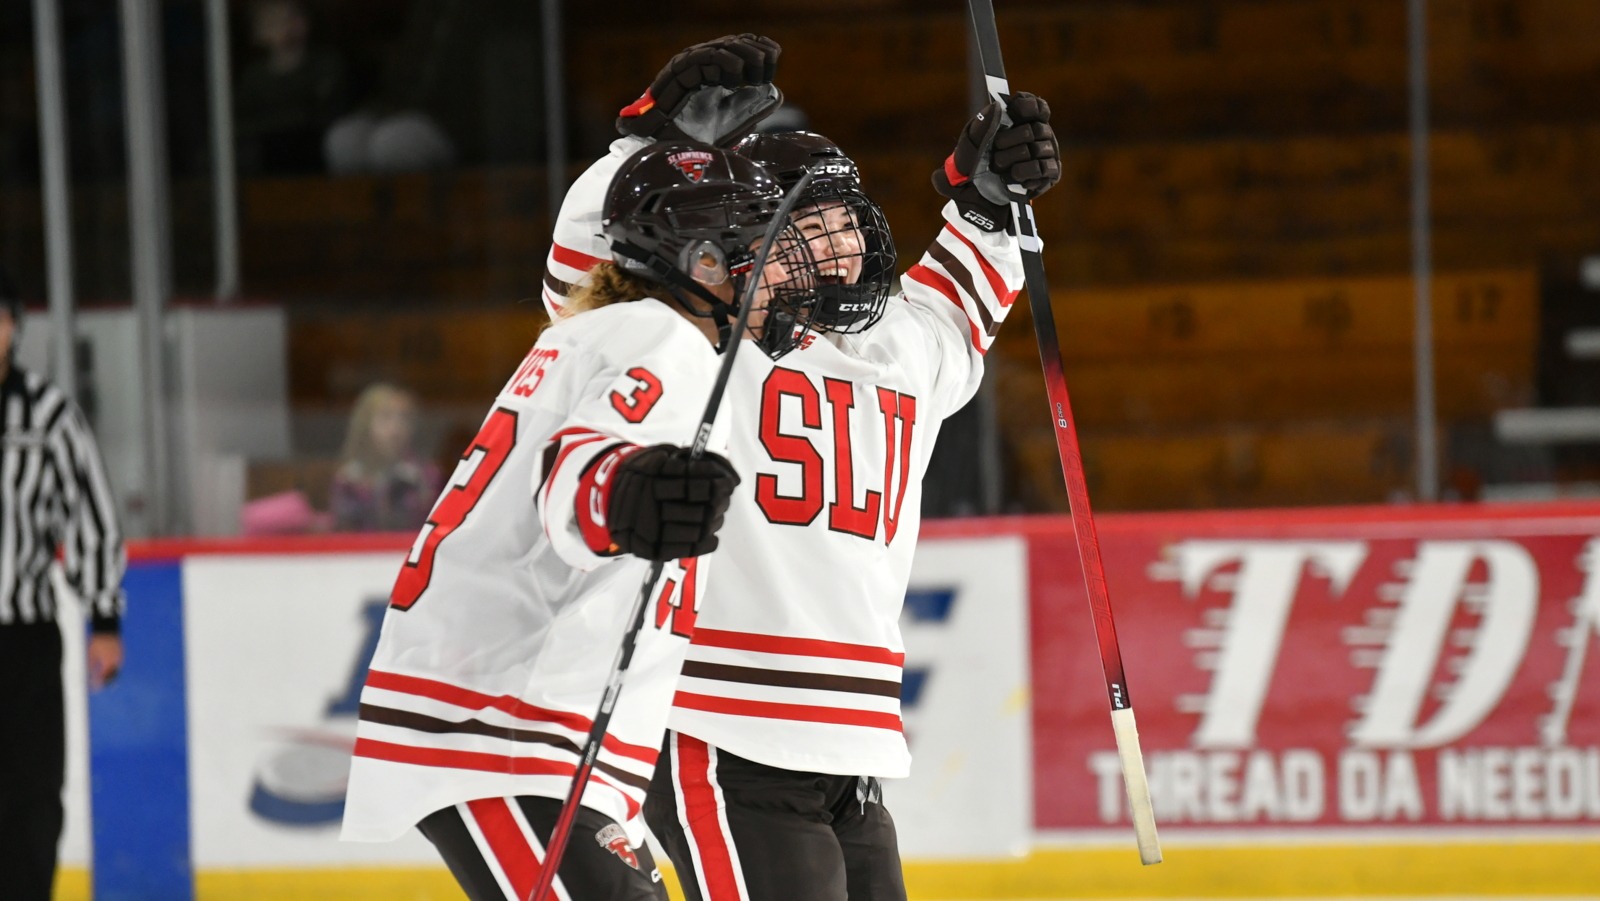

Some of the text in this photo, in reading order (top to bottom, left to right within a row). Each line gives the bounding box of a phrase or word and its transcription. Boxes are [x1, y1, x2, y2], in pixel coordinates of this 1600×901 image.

[963, 211, 995, 231] CCM
[506, 347, 560, 397] VES
[609, 366, 664, 424] 3
[755, 365, 916, 548] SLU
